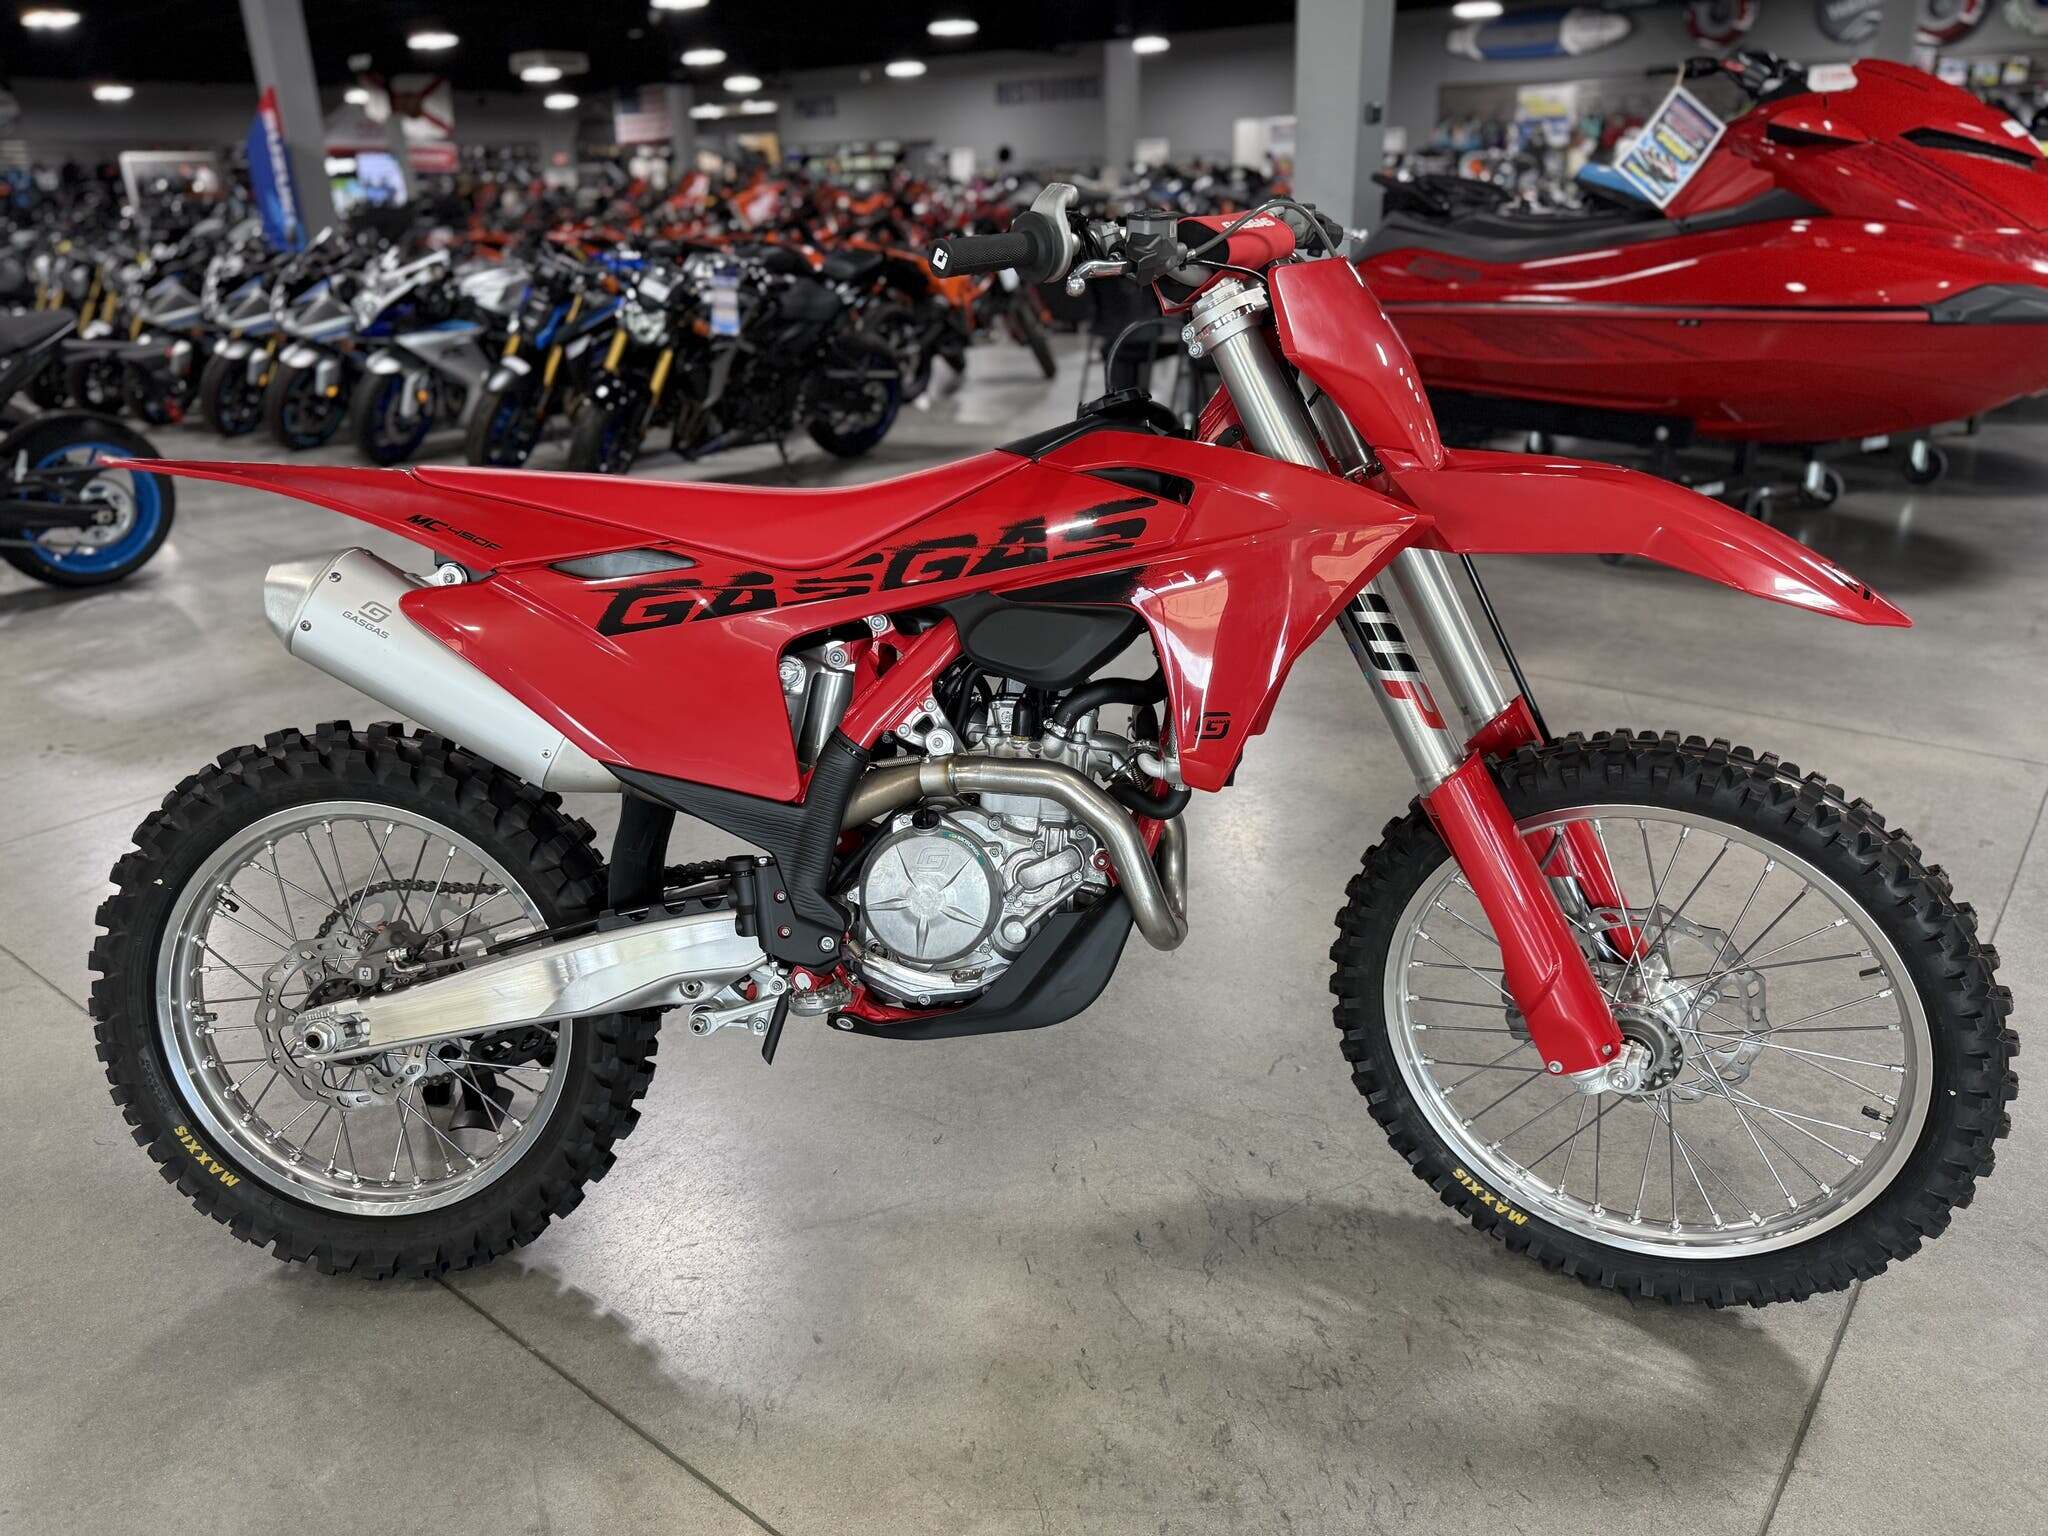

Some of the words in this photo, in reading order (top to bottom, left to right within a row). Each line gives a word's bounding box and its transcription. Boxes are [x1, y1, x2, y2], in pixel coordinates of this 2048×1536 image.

[590, 496, 1159, 637] GASGAS
[342, 610, 390, 639] GASGAS
[174, 1125, 241, 1187] MAXXIS
[1452, 1168, 1528, 1226] MAXXIS
